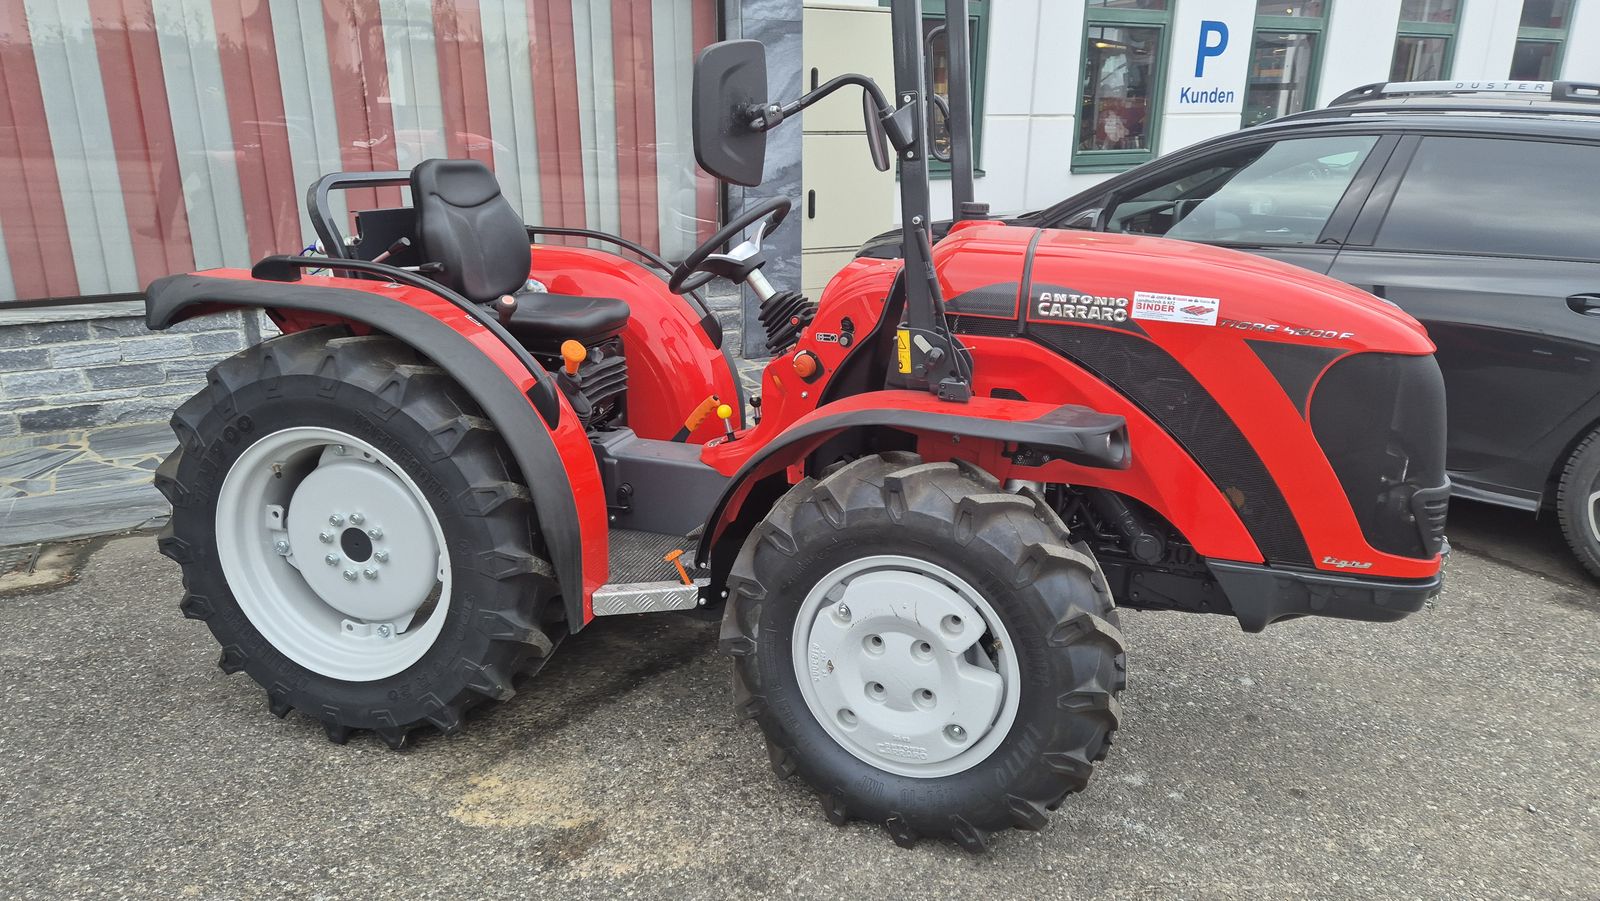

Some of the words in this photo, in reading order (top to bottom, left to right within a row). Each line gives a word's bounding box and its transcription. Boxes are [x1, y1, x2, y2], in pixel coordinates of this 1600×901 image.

[1194, 20, 1229, 78] P
[1455, 82, 1545, 91] DUSTER
[1180, 86, 1235, 104] Kunden
[1040, 292, 1129, 307] ANTONIO
[1038, 302, 1128, 322] CARRARO
[1136, 303, 1175, 313] BINDER
[1220, 319, 1280, 332] TIGRE
